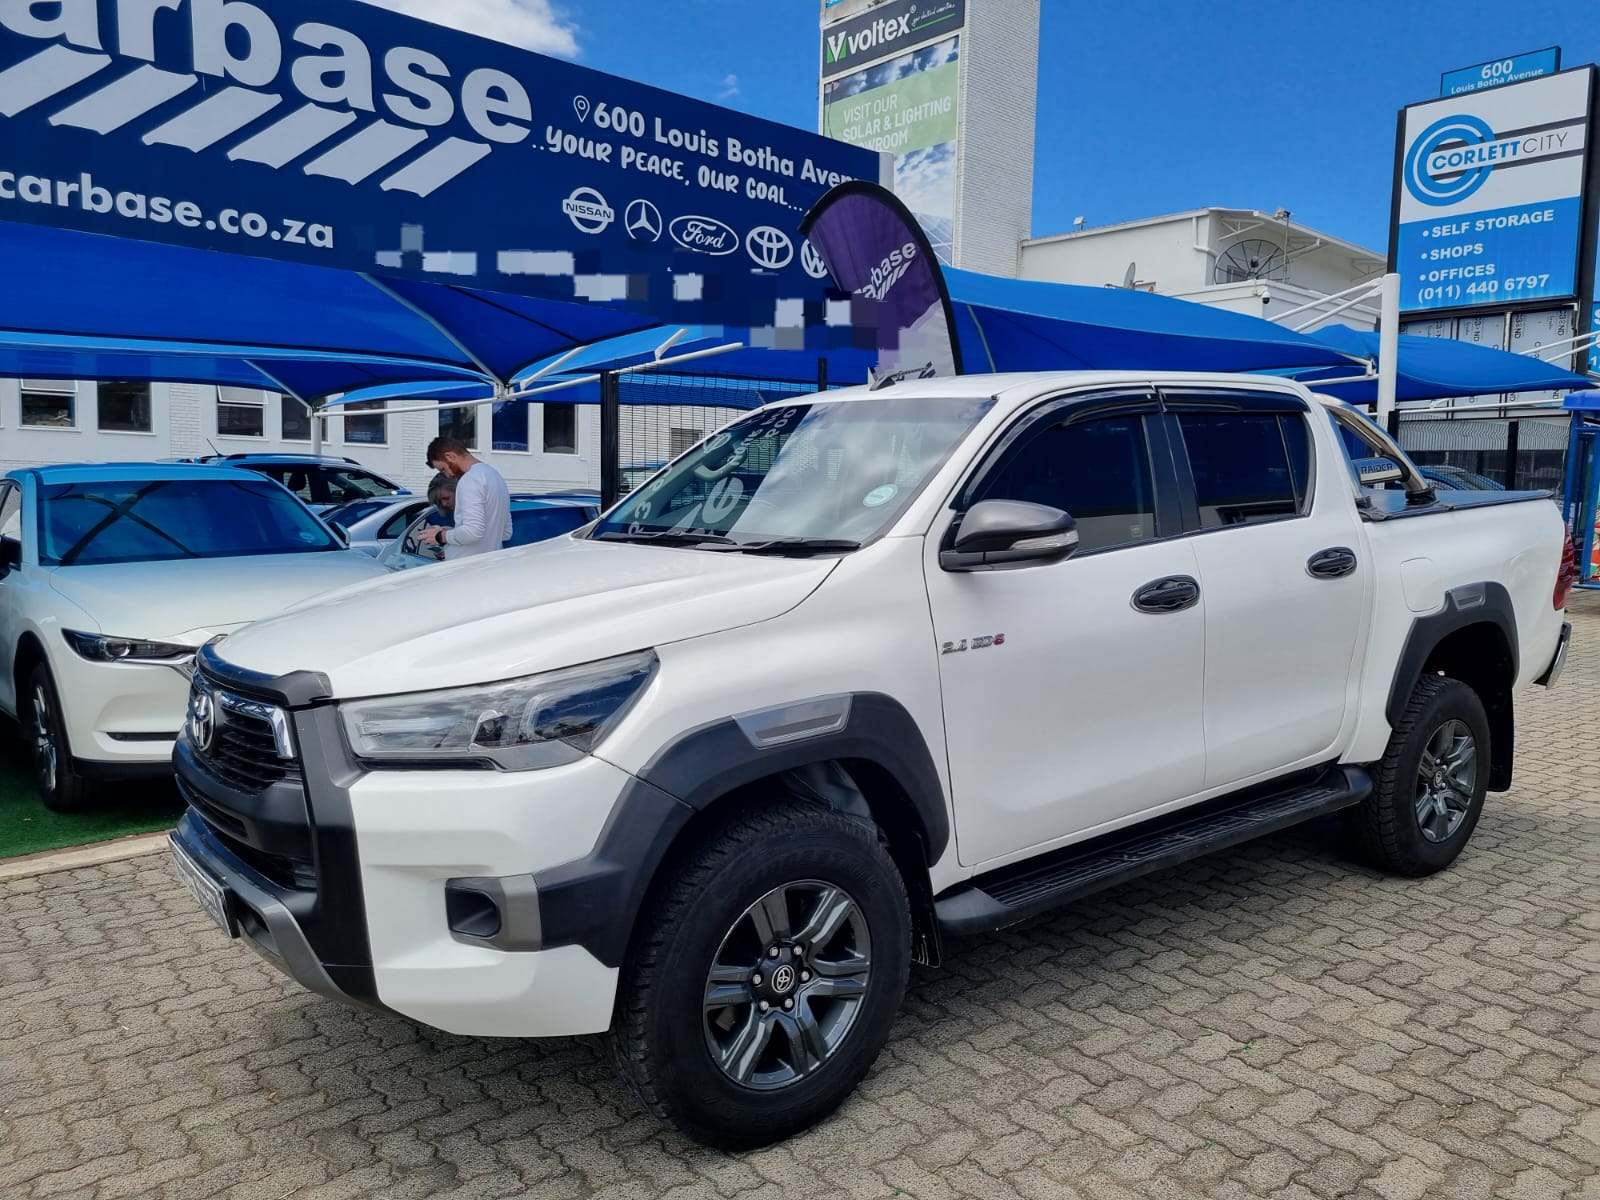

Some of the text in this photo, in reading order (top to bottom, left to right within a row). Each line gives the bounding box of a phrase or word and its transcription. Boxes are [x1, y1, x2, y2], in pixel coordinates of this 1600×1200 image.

[1451, 68, 1543, 95] Louis Botha Avenue
[1481, 60, 1513, 79] 600
[843, 94, 898, 123] VISIT OUR
[843, 96, 952, 142] SOLAR & LIGHTING
[593, 102, 645, 137] 600
[654, 117, 719, 157] Louis
[727, 137, 794, 177] Botha
[698, 165, 739, 193] OUR
[0, 170, 334, 249] carbase.co.za
[565, 202, 612, 219] NISSAN
[1432, 209, 1555, 238] SELF STORAGE
[682, 219, 727, 250] Ford
[1430, 243, 1484, 261] SHOPS
[1428, 263, 1496, 282] OFFICES
[1418, 274, 1550, 304] (011) 440 6797
